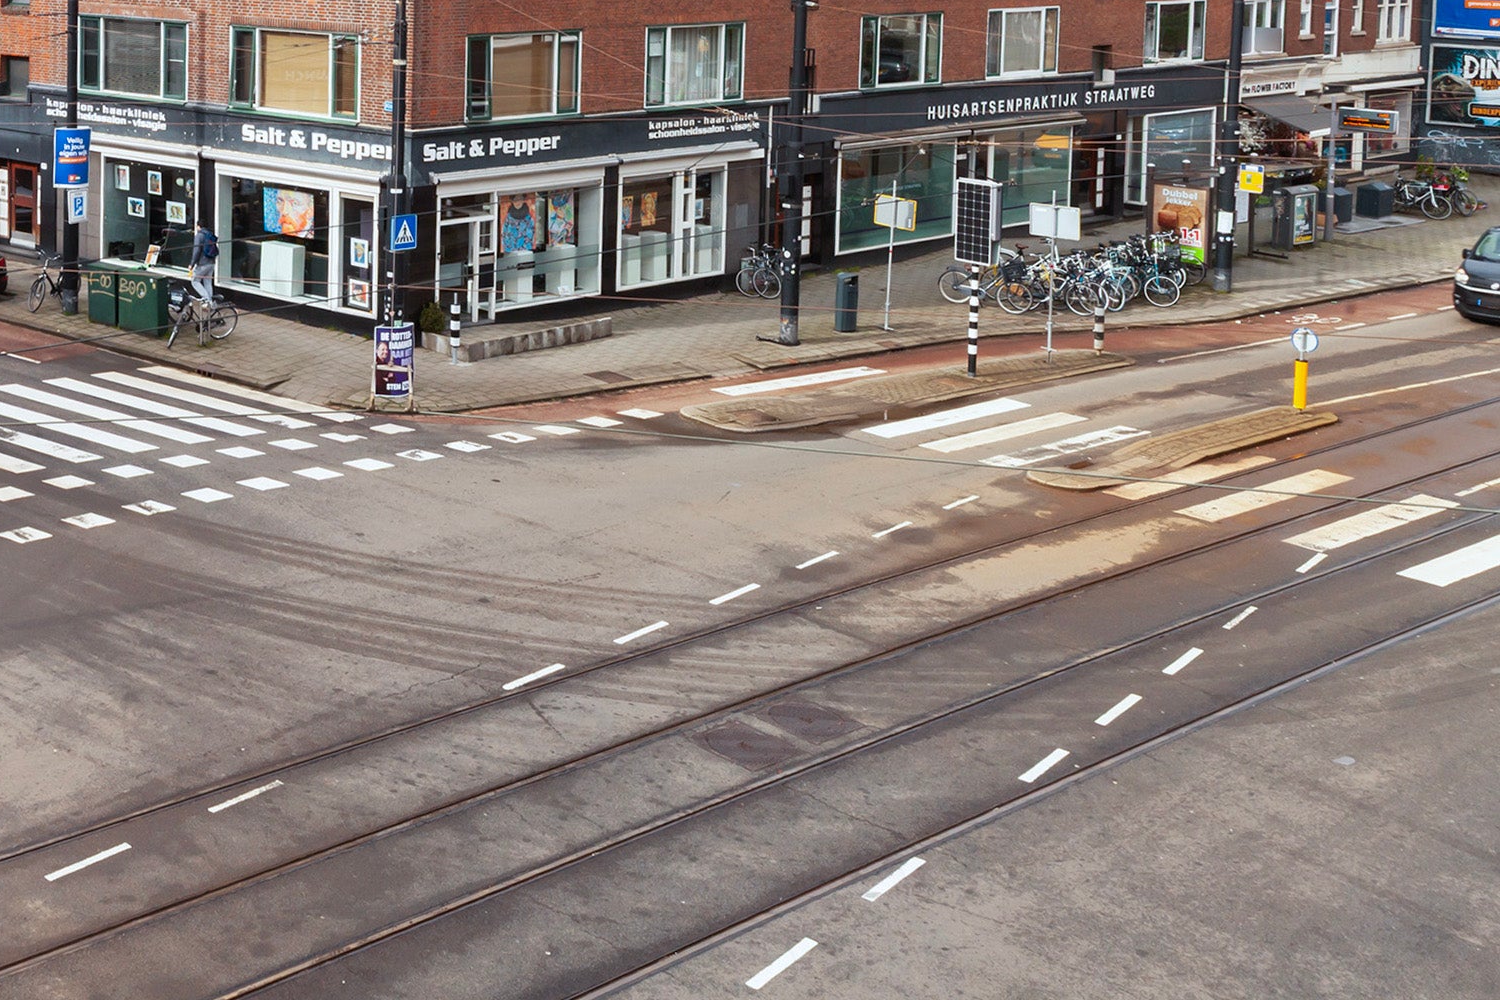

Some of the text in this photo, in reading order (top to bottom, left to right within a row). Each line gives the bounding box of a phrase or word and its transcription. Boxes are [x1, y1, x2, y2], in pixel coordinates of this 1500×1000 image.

[927, 84, 1155, 120] HUISARTSENPRAKTIJK STRAATWEG
[102, 104, 166, 122] haarkliniek
[648, 125, 725, 140] schoonheidssalon
[649, 118, 695, 131] kapsalon
[241, 123, 286, 146] Salt
[289, 129, 307, 149] &
[423, 135, 561, 162] Salt & Pepper
[1162, 188, 1198, 200] Dubbel
[1181, 228, 1200, 241] 1+1
